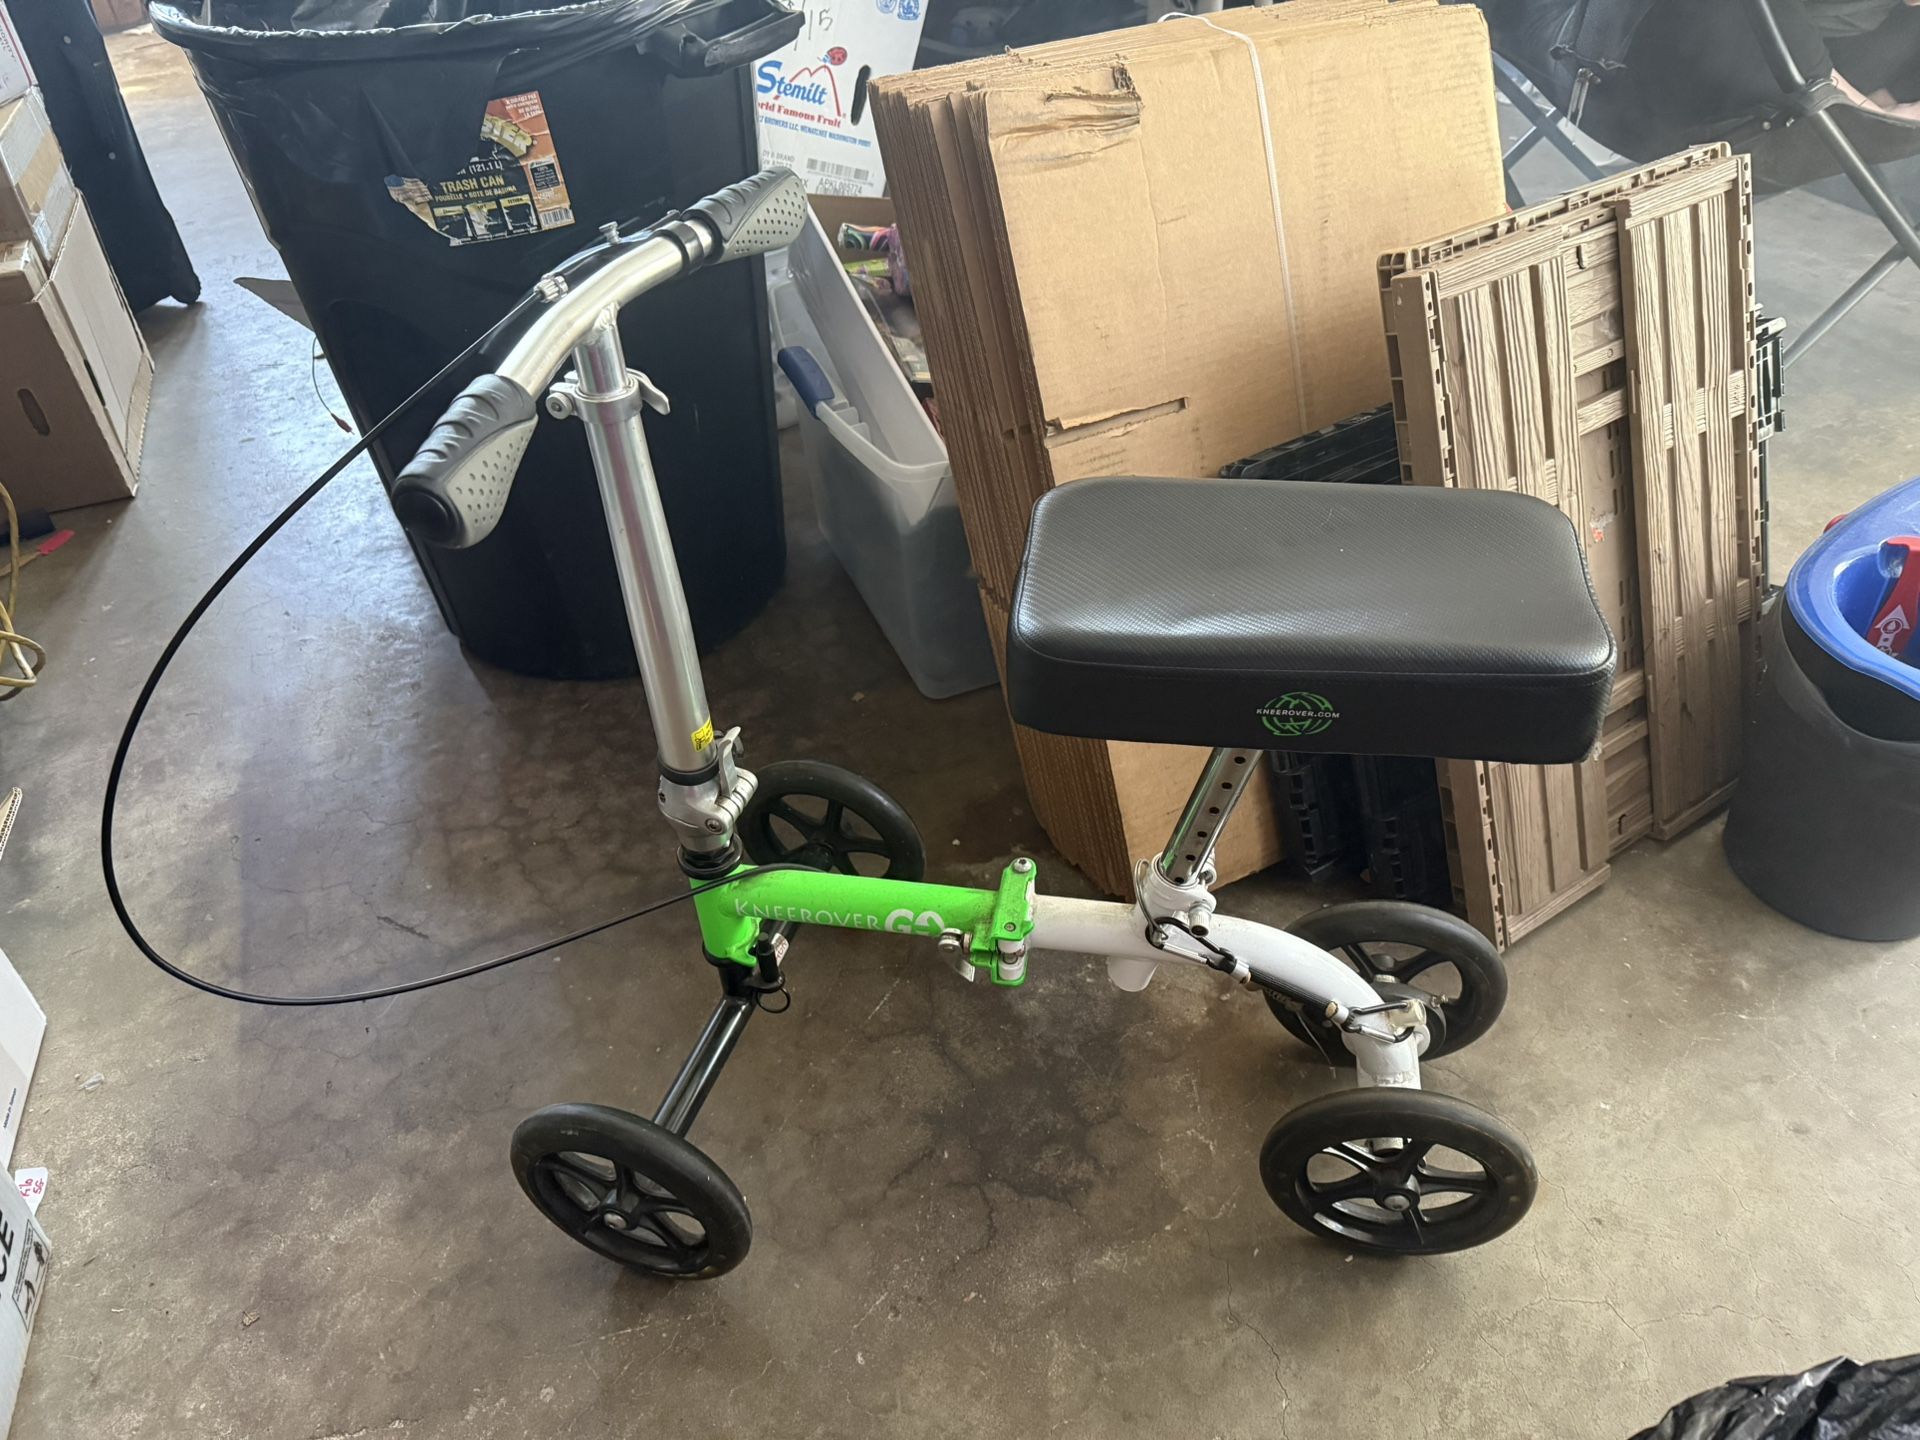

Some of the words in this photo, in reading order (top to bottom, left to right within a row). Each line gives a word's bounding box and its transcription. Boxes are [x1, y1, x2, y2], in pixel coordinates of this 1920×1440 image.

[757, 60, 828, 105] Stemilt
[778, 105, 815, 121] Famous
[817, 114, 842, 129] Fruit
[440, 178, 479, 193] TRASH
[480, 175, 505, 189] CAN
[1256, 708, 1340, 719] KNEEROVER.COM
[735, 898, 880, 930] KNEEROVER
